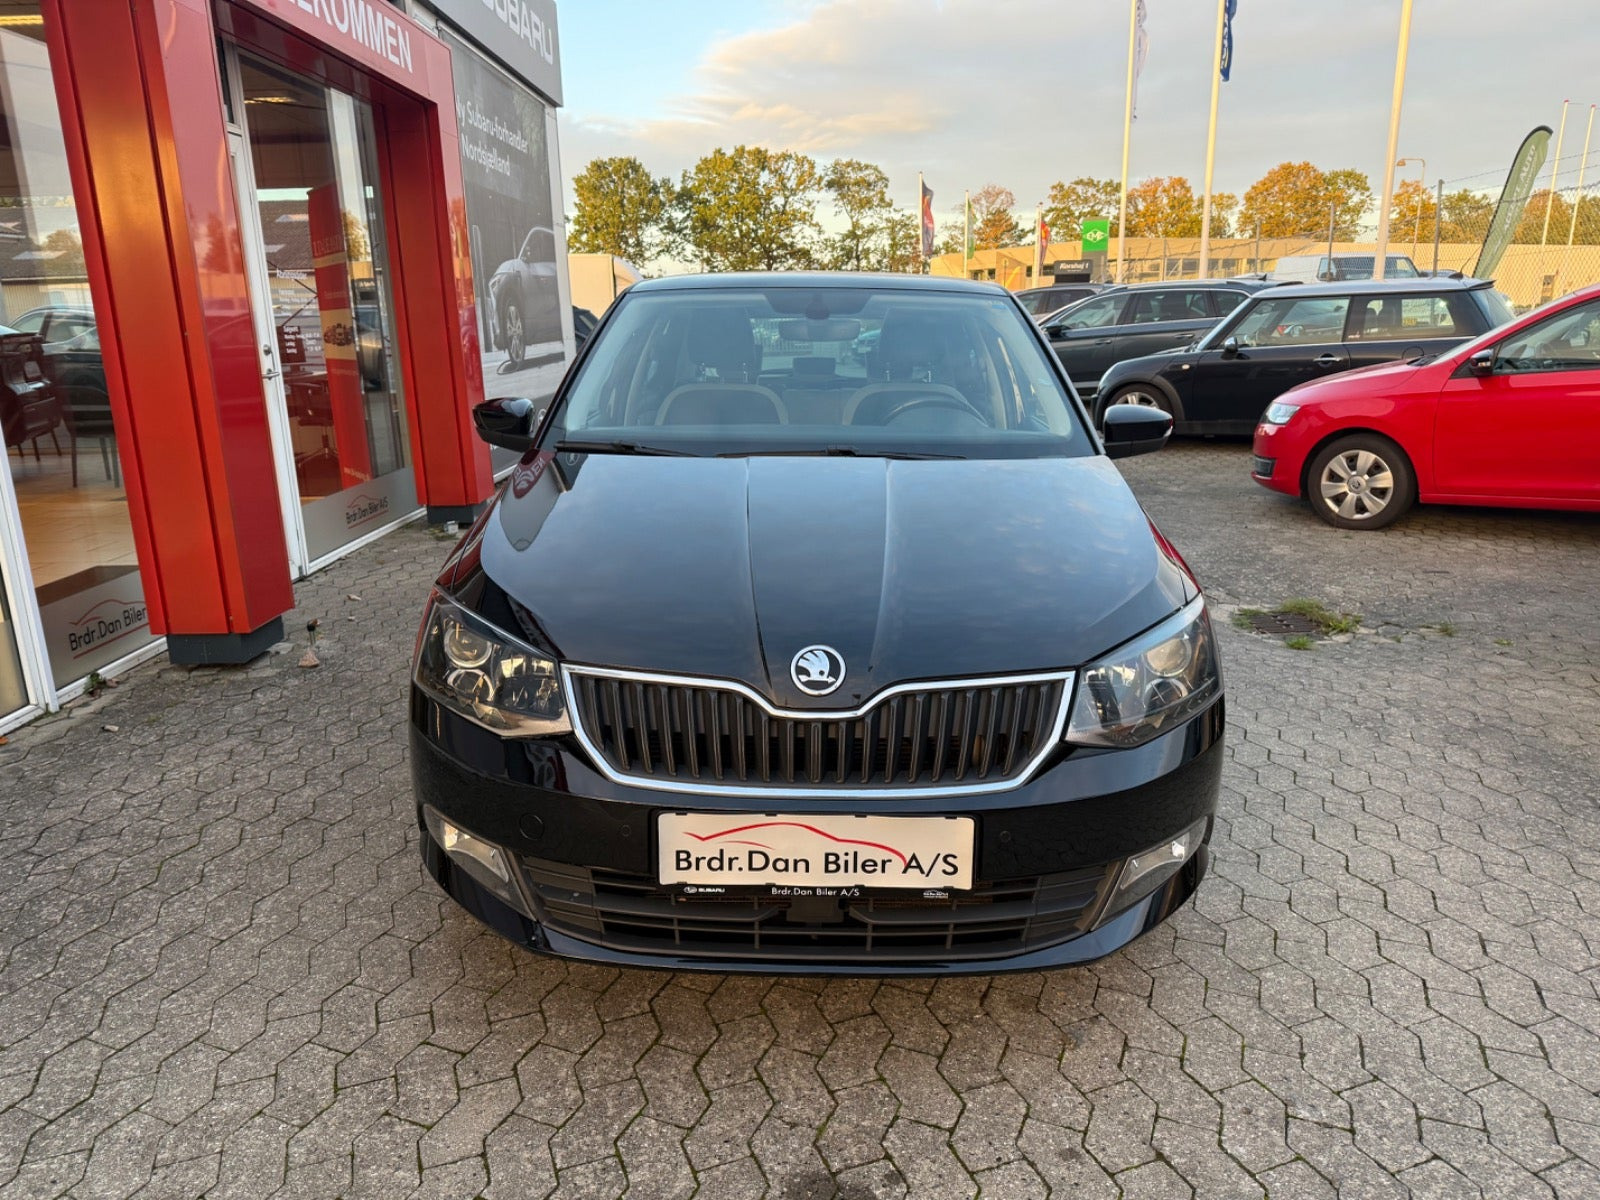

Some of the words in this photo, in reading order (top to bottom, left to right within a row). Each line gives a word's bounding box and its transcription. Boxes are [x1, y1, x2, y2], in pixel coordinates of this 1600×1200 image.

[482, 0, 553, 65] UBARU
[824, 851, 892, 874] Biler
[902, 853, 959, 877] A/S
[816, 887, 837, 896] Biler
[840, 888, 860, 897] A/S
